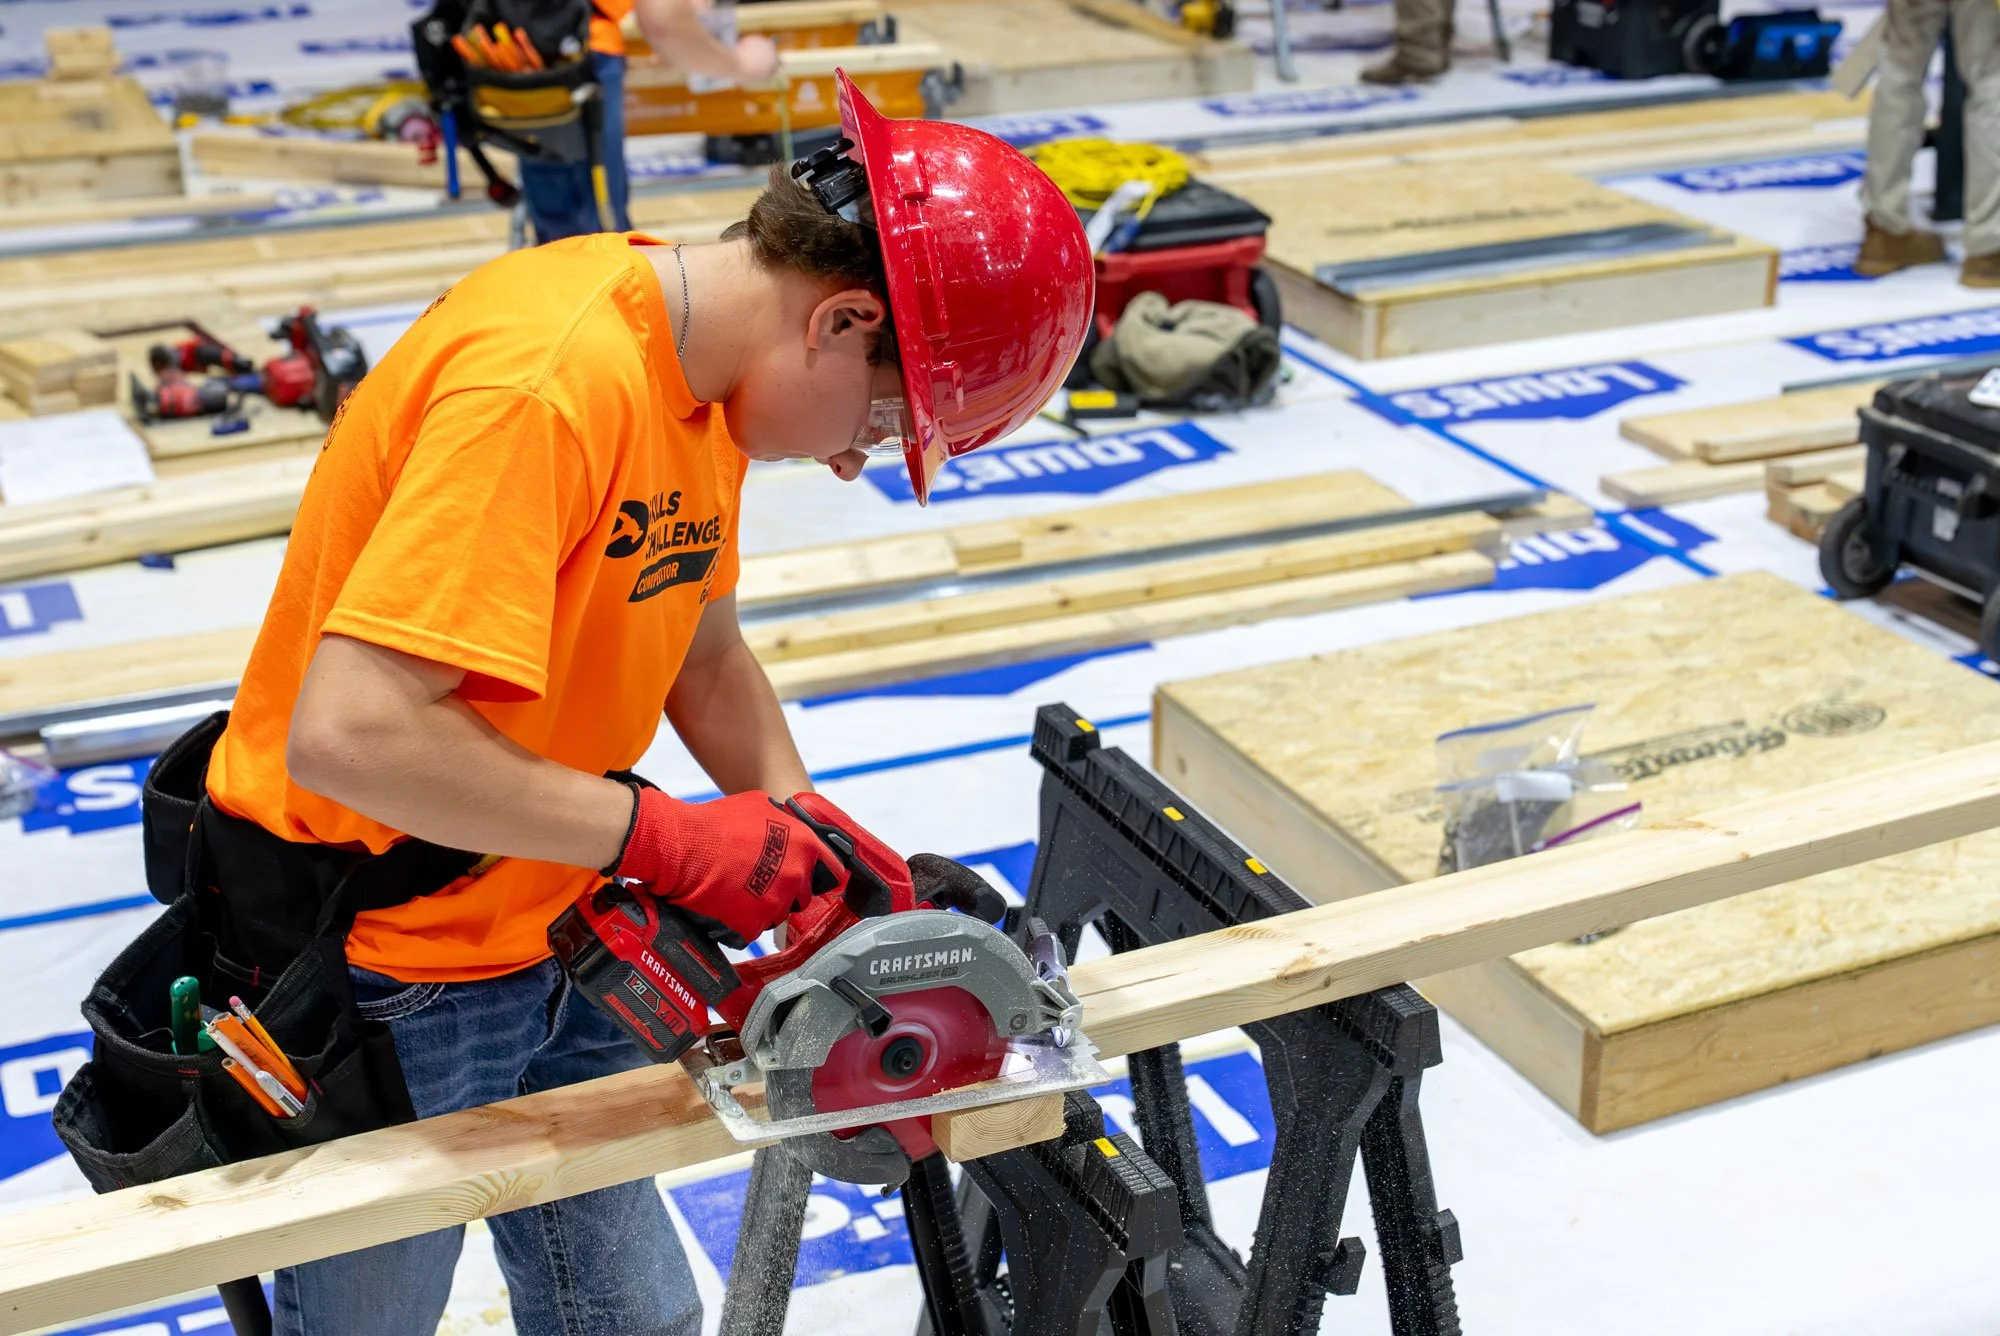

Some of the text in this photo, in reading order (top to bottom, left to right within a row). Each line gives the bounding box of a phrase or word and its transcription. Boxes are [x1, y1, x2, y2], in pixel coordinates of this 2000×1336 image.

[1391, 364, 1659, 418] LOWE'S
[641, 949, 697, 1010] CRAFTSMAN
[879, 970, 941, 985] BRUSHLESS
